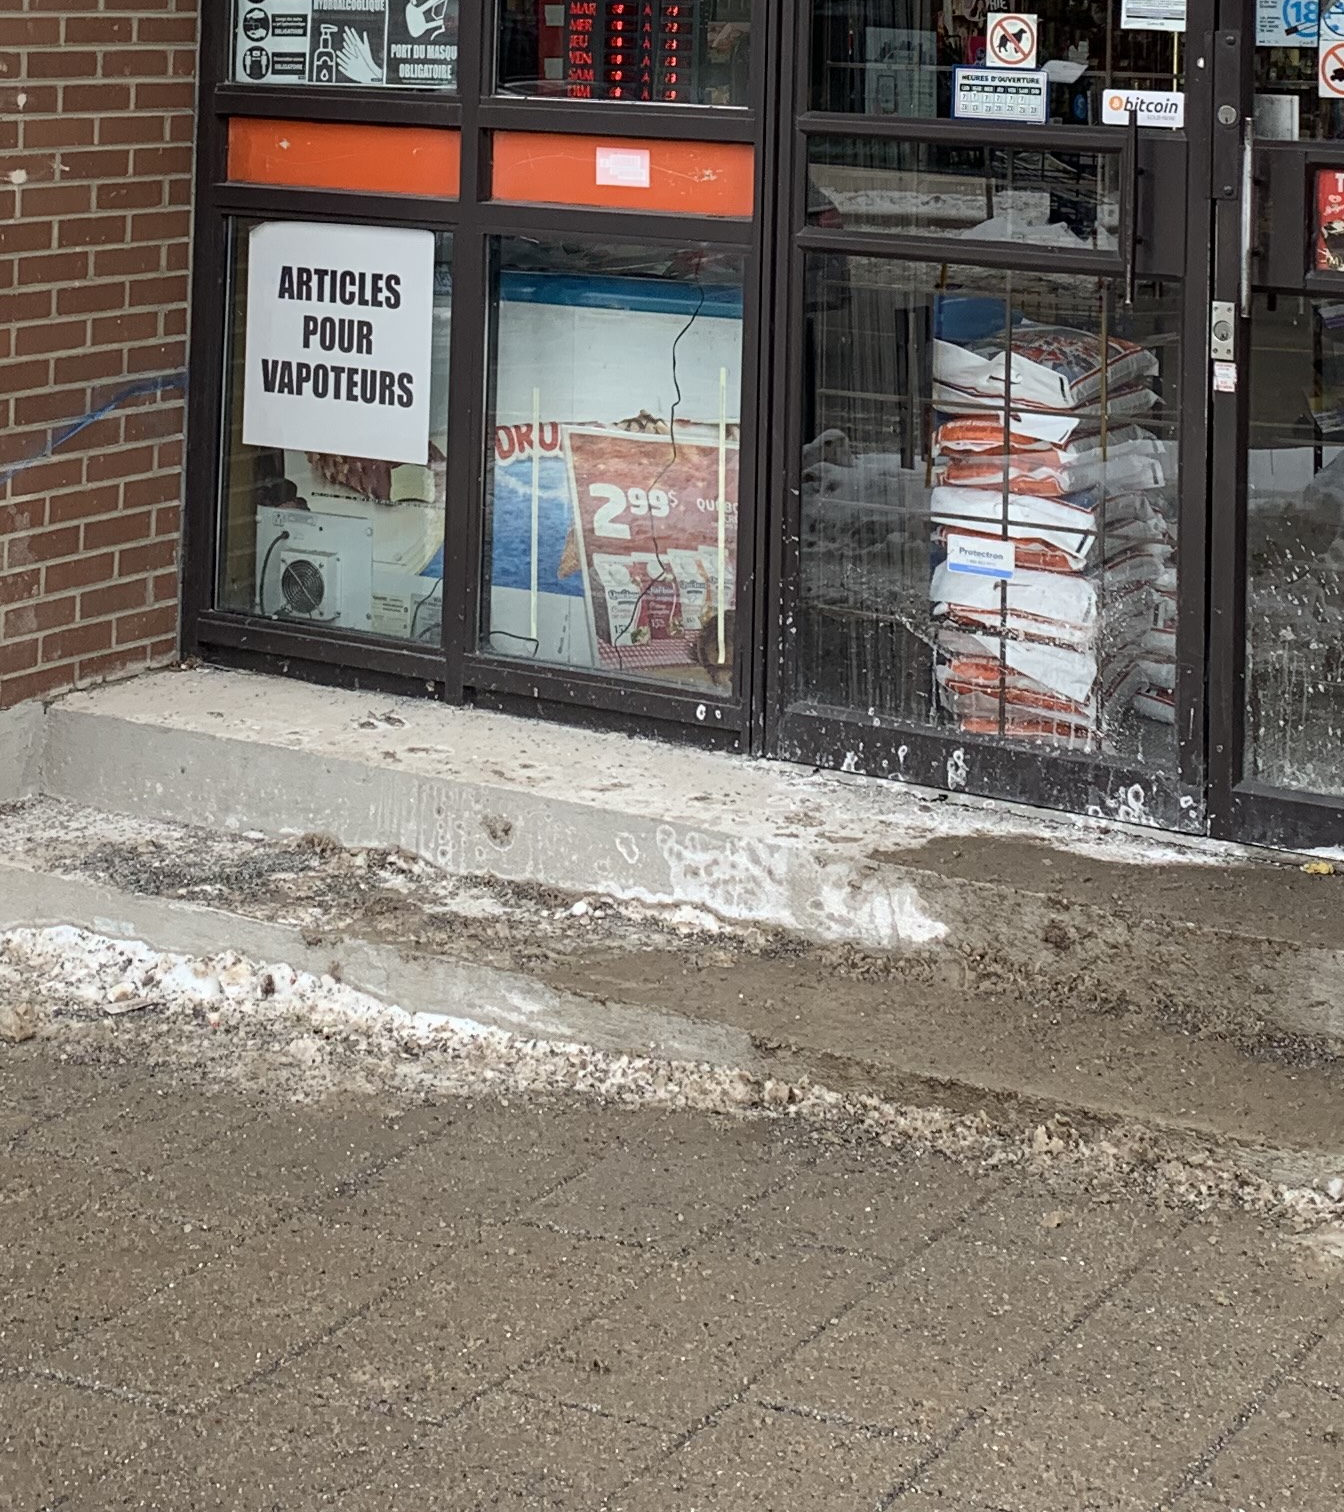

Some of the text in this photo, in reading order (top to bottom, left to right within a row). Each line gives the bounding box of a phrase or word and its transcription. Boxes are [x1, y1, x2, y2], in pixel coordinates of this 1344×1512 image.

[391, 44, 411, 59] PORT
[413, 45, 426, 59] DU
[399, 64, 452, 79] OBLIGATOIRE
[962, 74, 1040, 85] HEURES D'OUVERTURE
[1124, 95, 1179, 114] bitcoin
[278, 265, 402, 310] ARTICLES
[302, 315, 374, 355] POUR
[261, 358, 414, 409] VAPOTEURS
[959, 547, 1004, 560] Protectron
